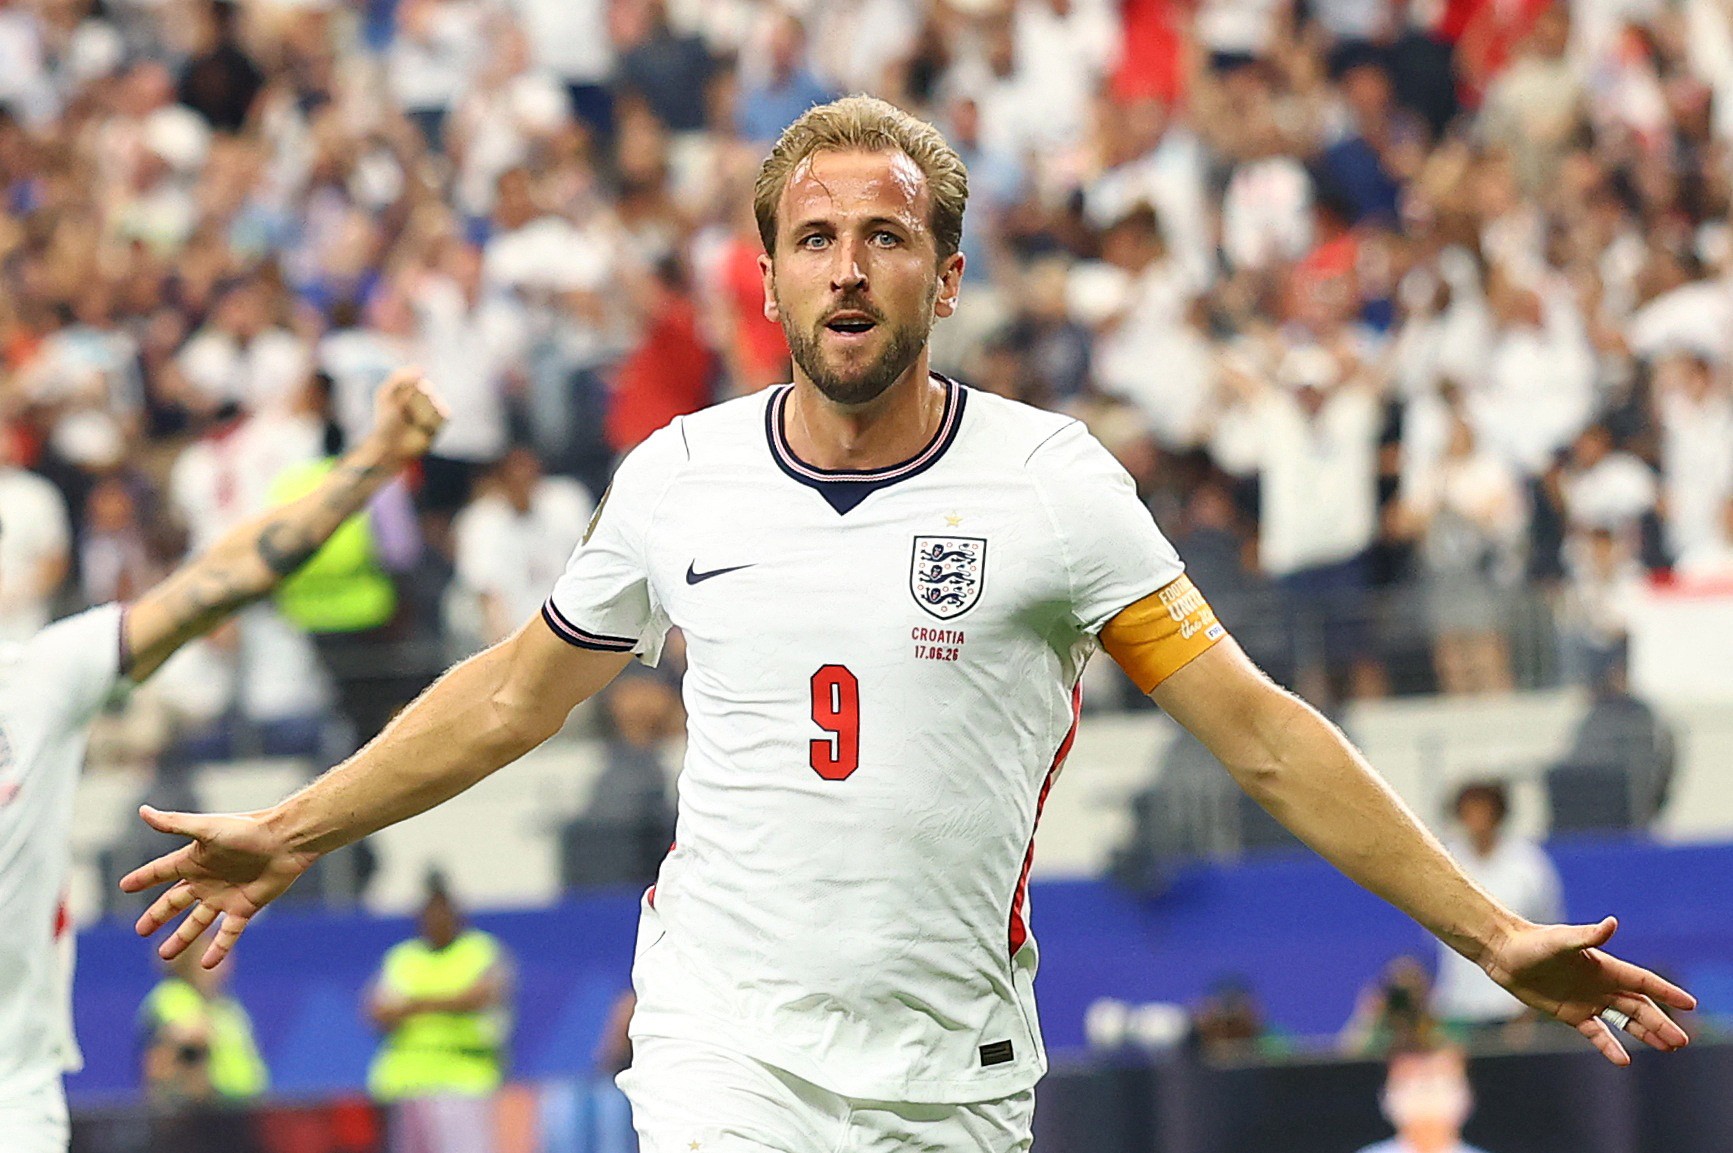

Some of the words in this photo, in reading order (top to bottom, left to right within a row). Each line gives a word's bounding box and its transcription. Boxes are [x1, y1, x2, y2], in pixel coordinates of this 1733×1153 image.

[911, 626, 965, 645] CROATIA
[915, 645, 959, 662] 17.06.26
[809, 663, 860, 781] 9
